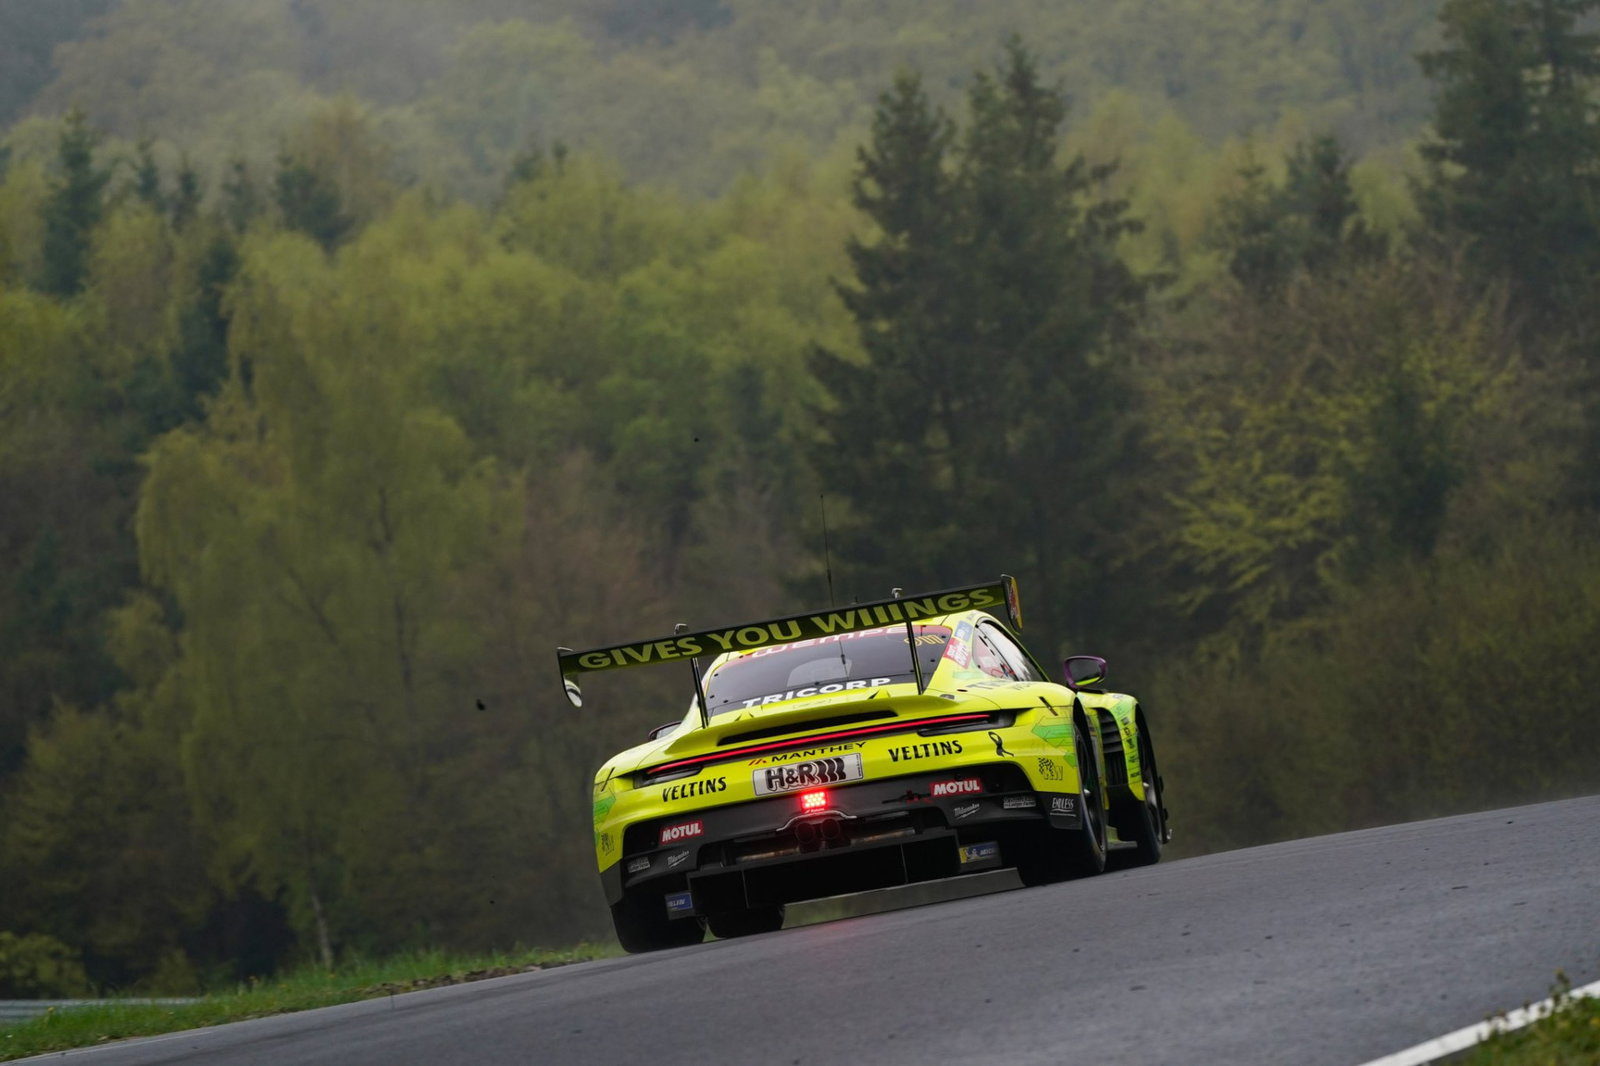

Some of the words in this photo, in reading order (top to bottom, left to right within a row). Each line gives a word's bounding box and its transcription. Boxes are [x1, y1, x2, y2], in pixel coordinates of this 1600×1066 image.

[578, 636, 703, 668] GIVES
[706, 620, 801, 650] YOU
[810, 588, 995, 633] WIIINGS
[742, 677, 892, 710] TRICORP
[771, 741, 866, 763] MANTHEY
[888, 740, 963, 763] VELTINS
[662, 776, 727, 803] VELTINS
[933, 779, 980, 796] MOTUL
[662, 822, 702, 843] MOTUL
